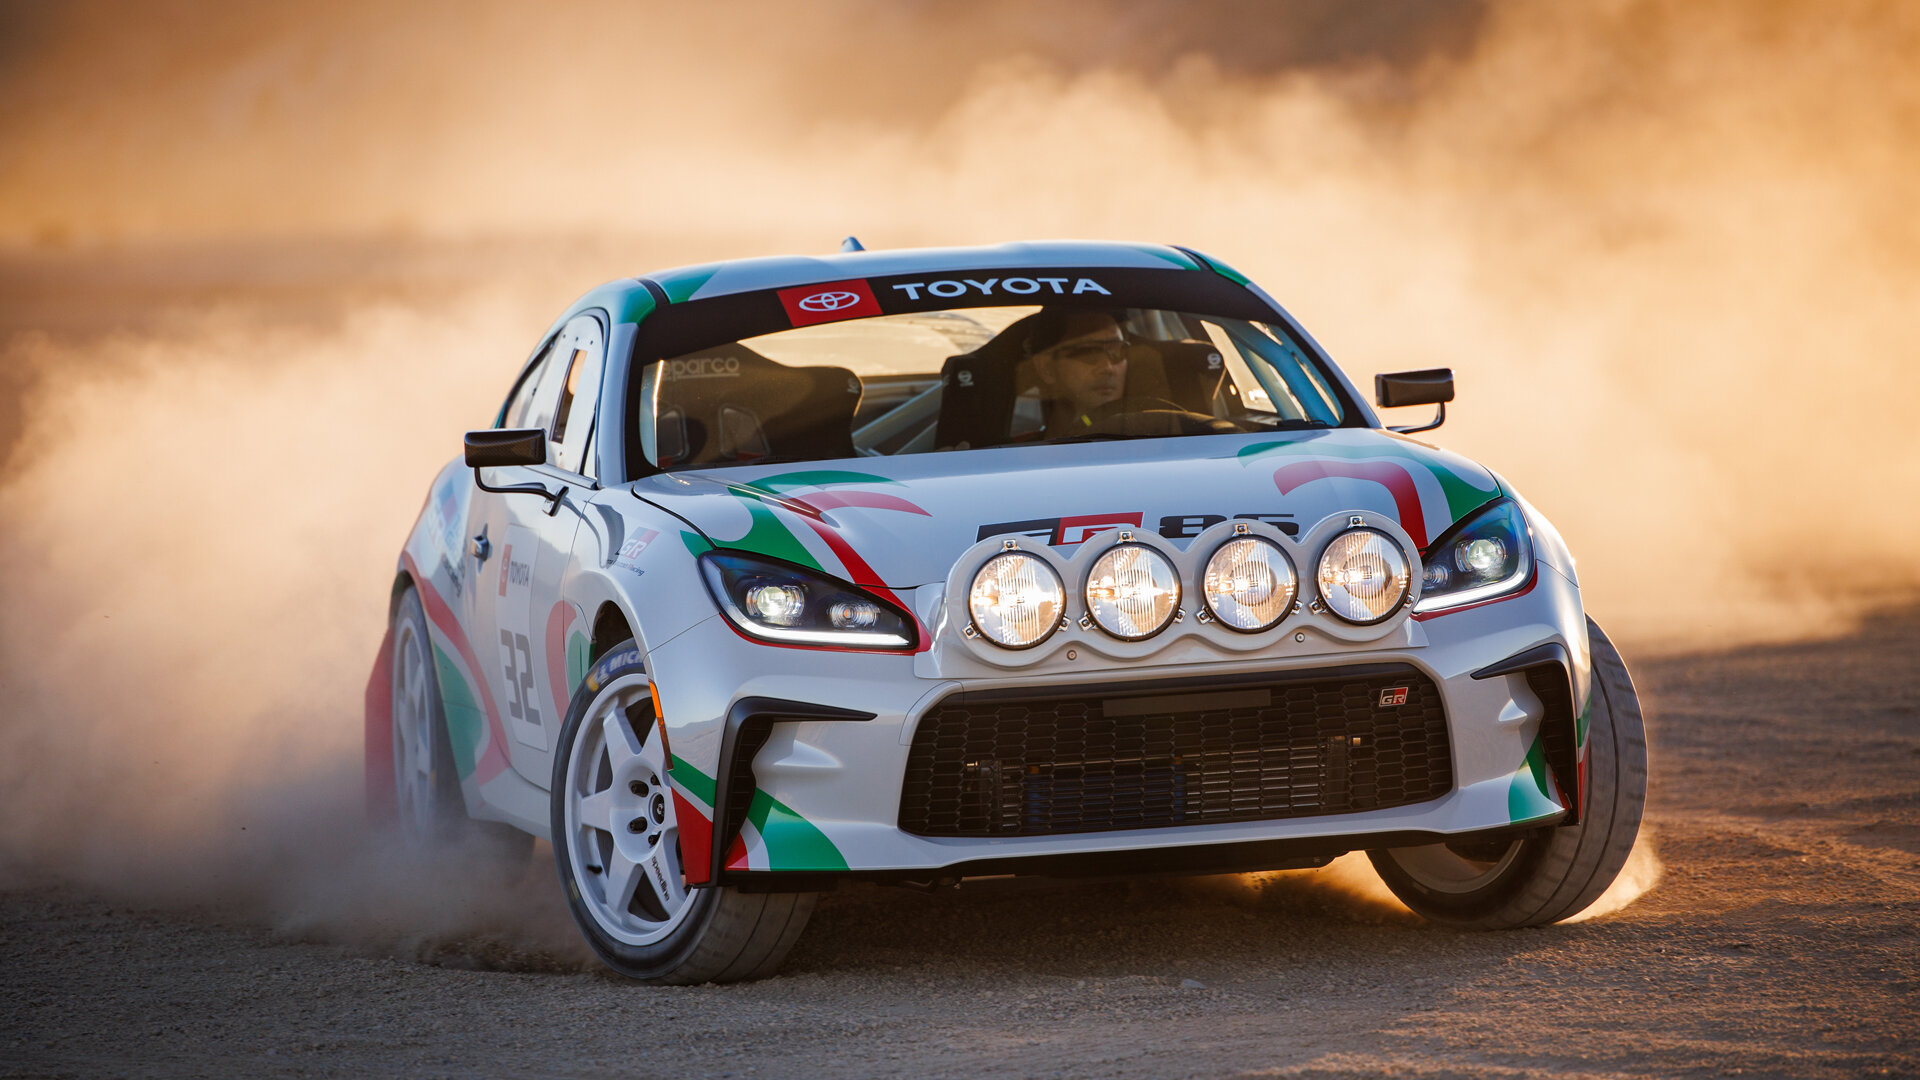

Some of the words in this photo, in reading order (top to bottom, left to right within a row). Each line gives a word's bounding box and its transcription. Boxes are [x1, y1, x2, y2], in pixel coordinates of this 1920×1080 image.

[892, 277, 1112, 300] TOYOTA
[620, 539, 648, 559] GR
[510, 561, 530, 587] TOYOTA
[500, 628, 542, 727] 32
